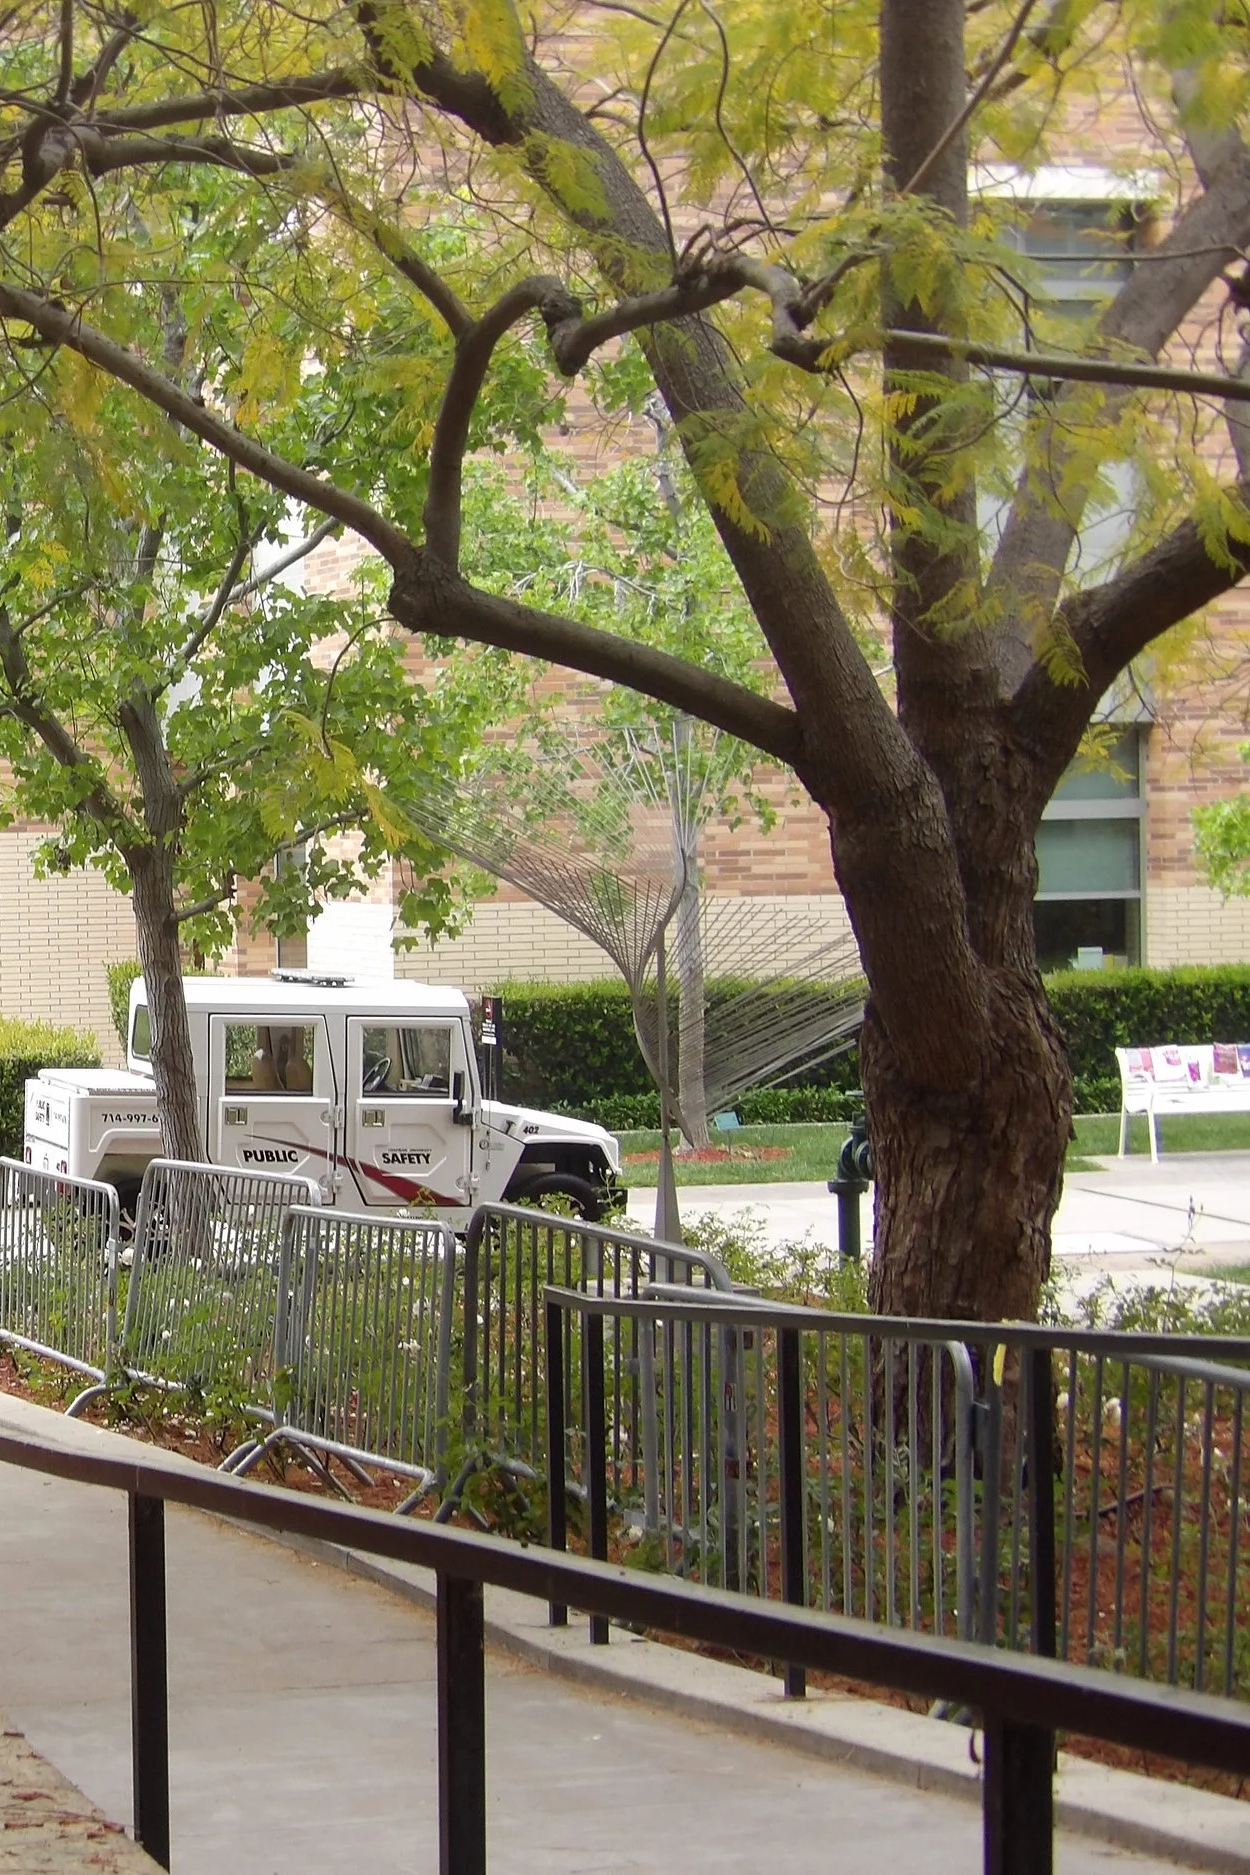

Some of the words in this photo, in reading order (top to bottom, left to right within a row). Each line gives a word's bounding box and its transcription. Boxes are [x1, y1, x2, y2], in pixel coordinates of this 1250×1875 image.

[101, 1113, 160, 1123] 714-997-6
[523, 1126, 540, 1135] 402
[242, 1149, 299, 1163] PUBLIC
[381, 1152, 431, 1165] SAFETY
